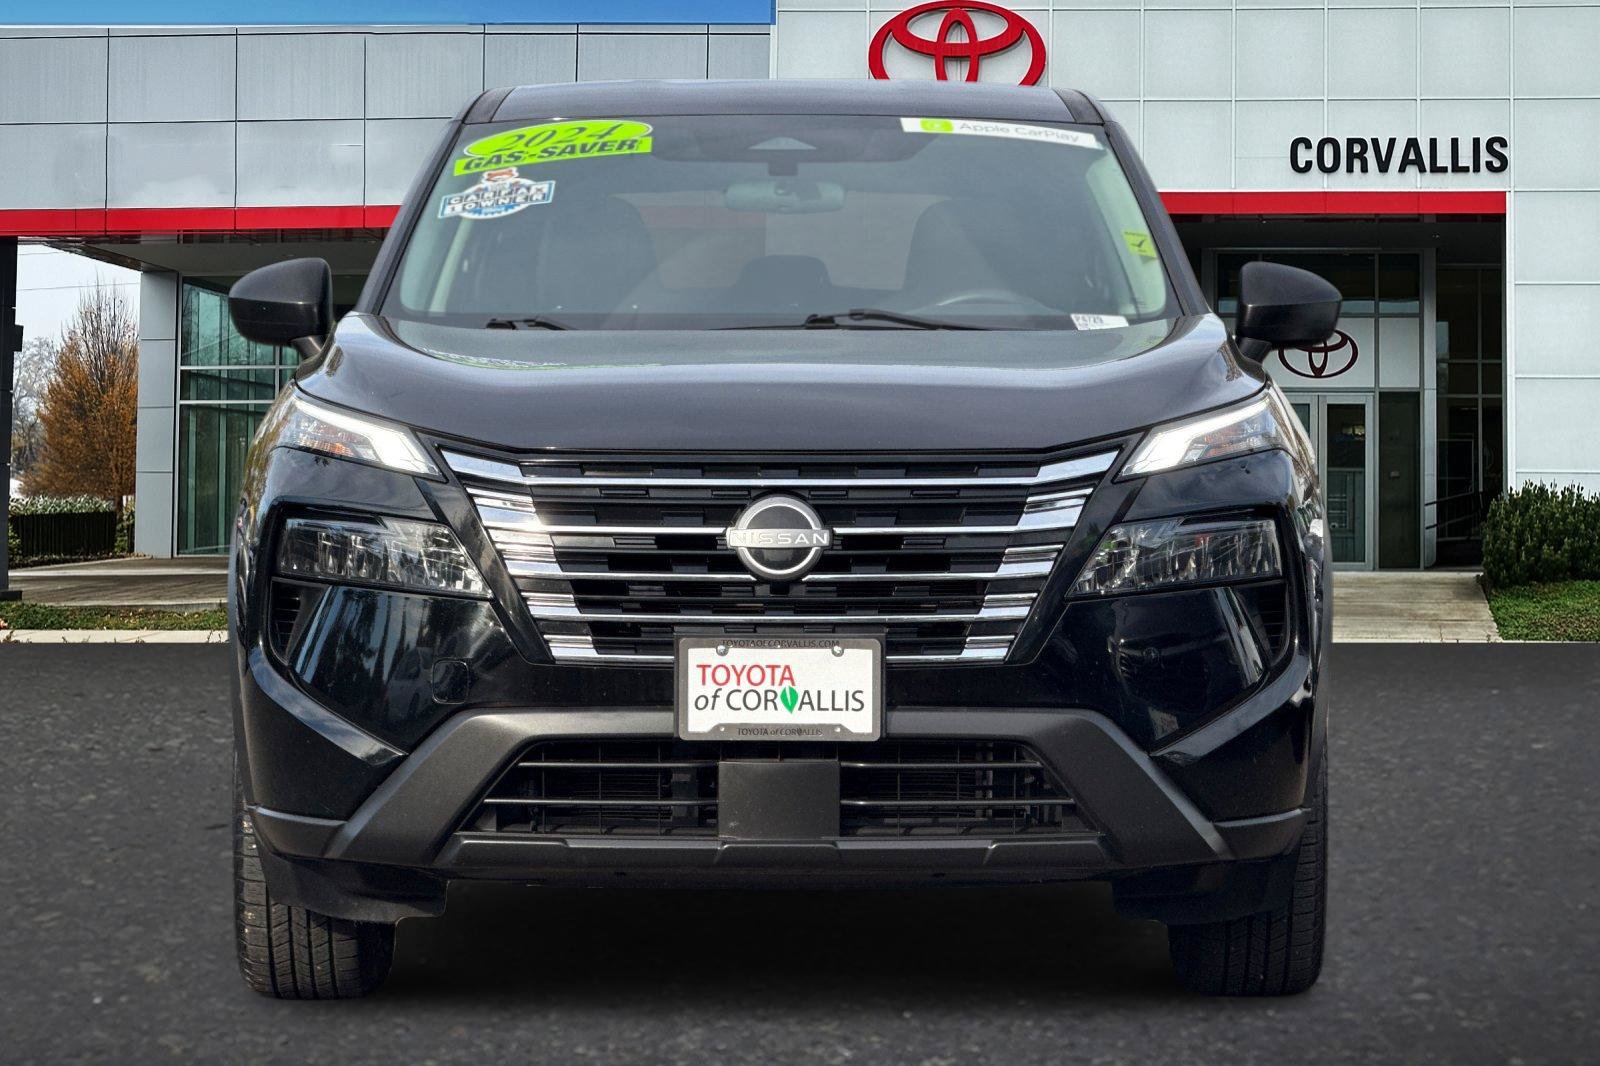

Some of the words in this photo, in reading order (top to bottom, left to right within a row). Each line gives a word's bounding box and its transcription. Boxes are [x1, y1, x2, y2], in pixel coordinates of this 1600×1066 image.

[489, 122, 625, 154] 2024
[960, 122, 1010, 136] Apple
[1015, 126, 1080, 143] CarPlay
[463, 138, 639, 170] GAS-SAVER
[1289, 136, 1509, 173] CORVALLIS
[732, 531, 828, 545] NISSAN
[696, 664, 796, 687] TOYOTA
[694, 687, 723, 711] of
[737, 727, 769, 736] TOYOTA
